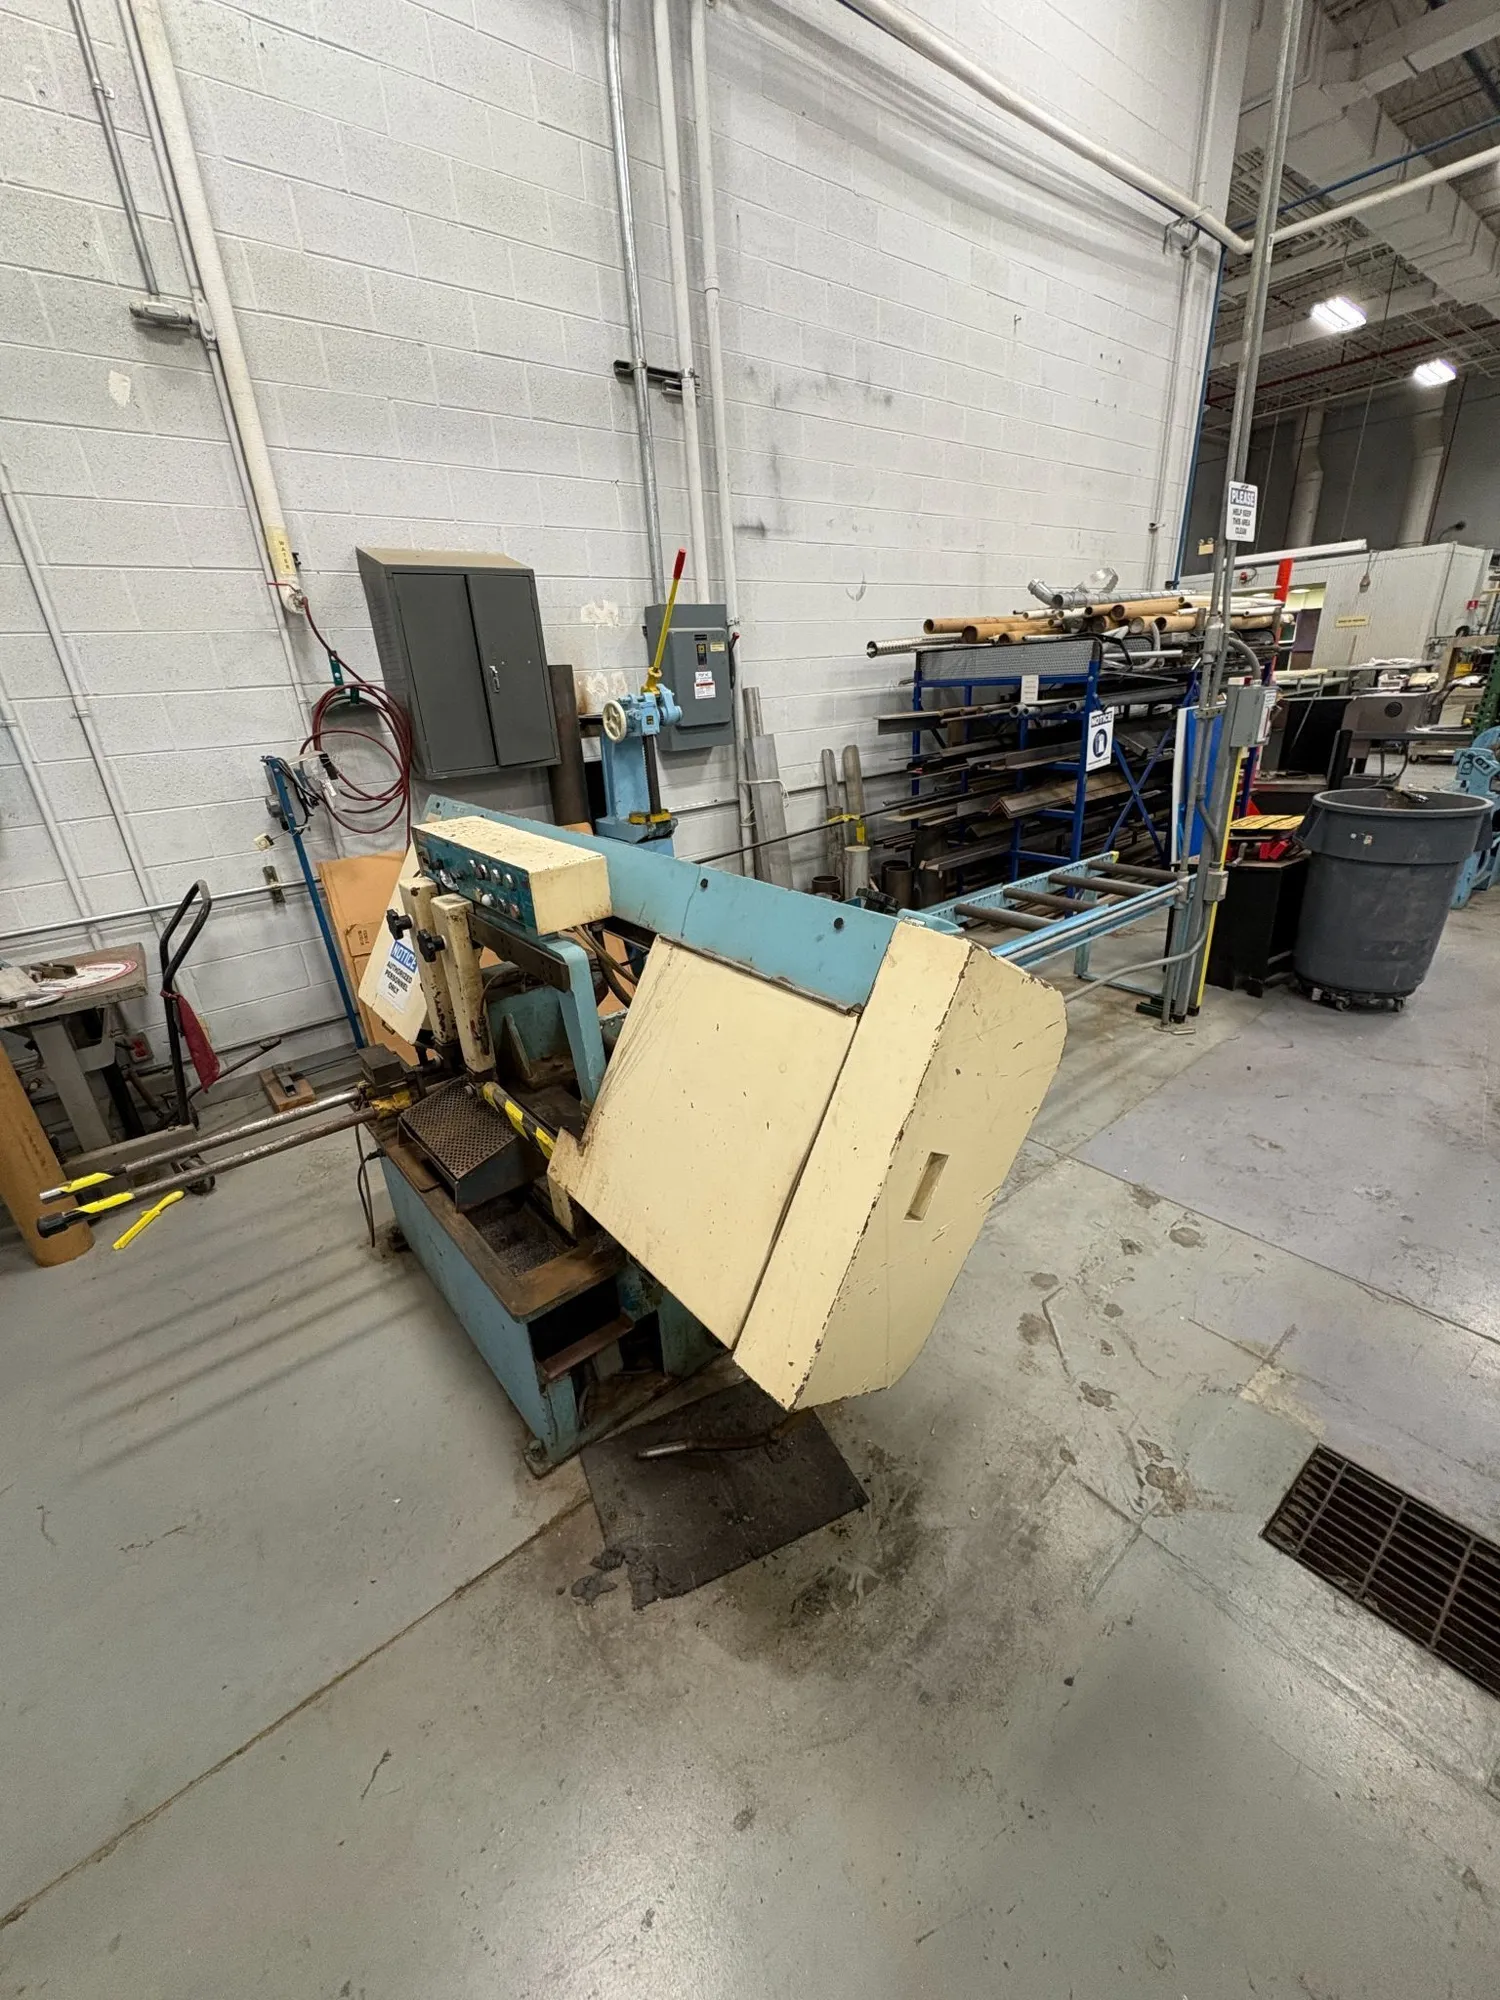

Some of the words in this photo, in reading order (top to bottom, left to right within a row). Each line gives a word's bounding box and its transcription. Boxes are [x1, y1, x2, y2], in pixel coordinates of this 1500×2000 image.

[1231, 488, 1255, 507] PLEASE
[1091, 712, 1112, 726] NOTICE
[391, 942, 416, 971] NOTICE
[385, 969, 408, 992] PERSONNEL
[387, 961, 412, 984] AUTHORIZED
[388, 982, 399, 994] ONLY
